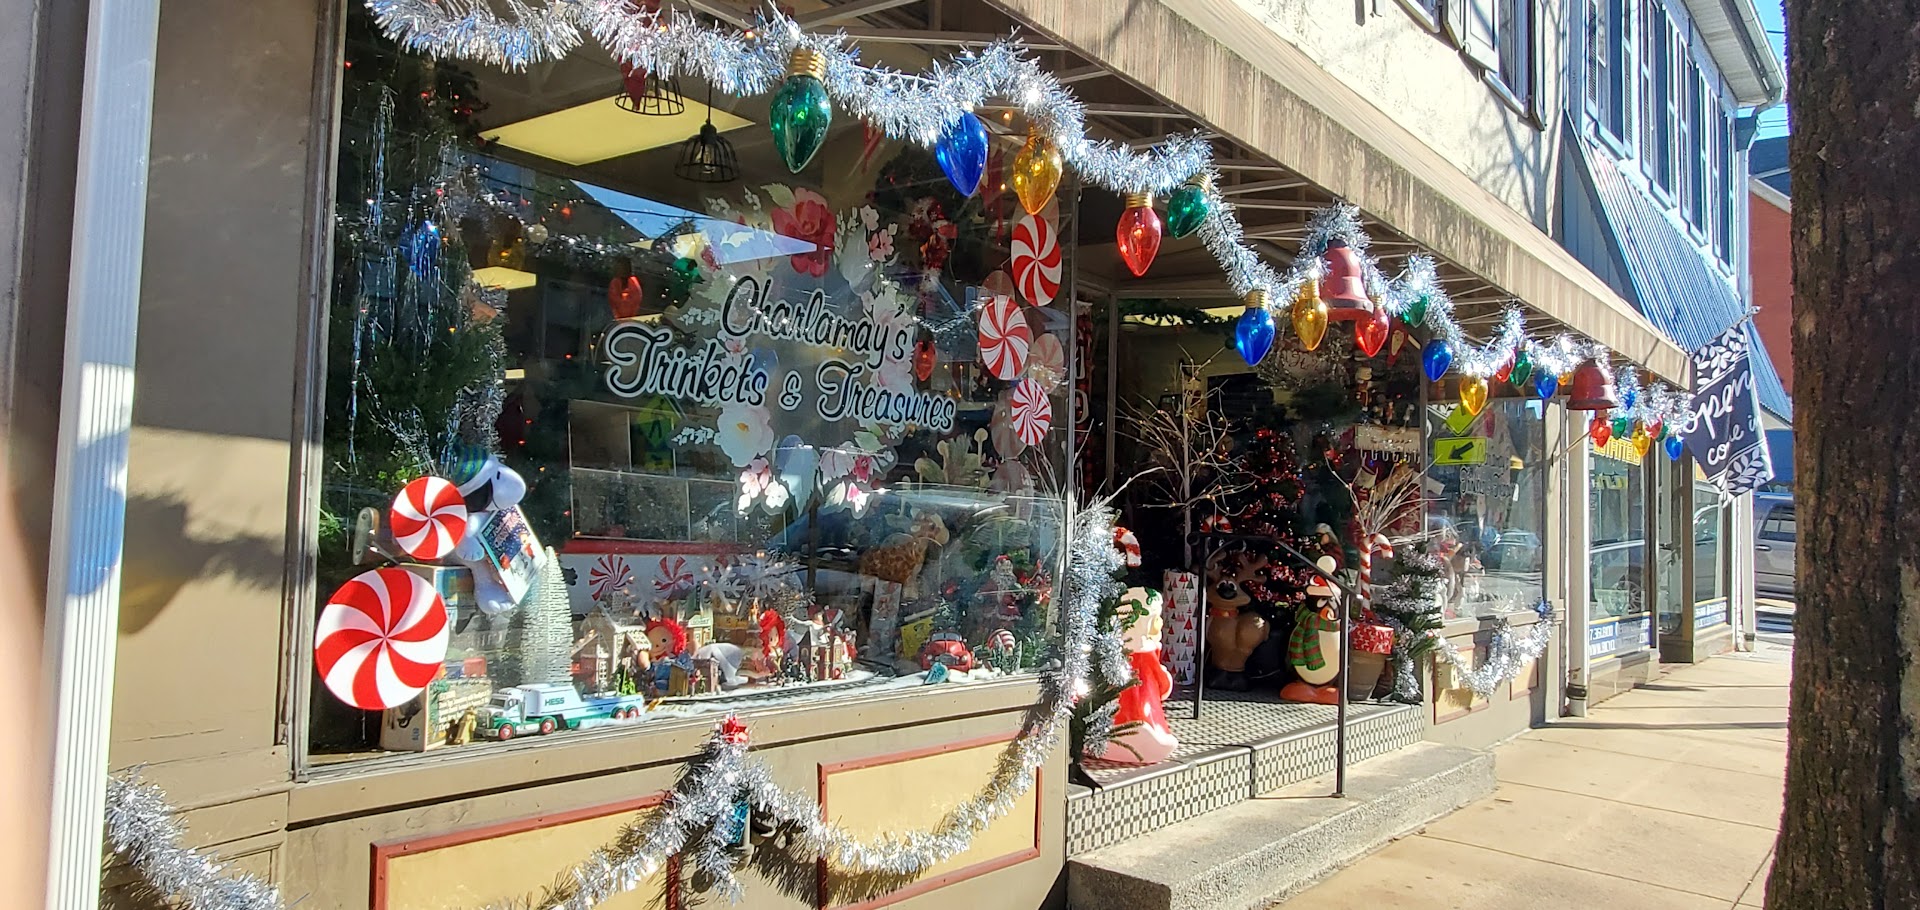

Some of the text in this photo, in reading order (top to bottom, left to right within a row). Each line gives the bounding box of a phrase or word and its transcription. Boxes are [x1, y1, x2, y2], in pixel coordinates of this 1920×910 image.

[720, 275, 909, 370] Charlamay's
[606, 323, 957, 433] Trinkets & Treasures
[1684, 370, 1753, 439] open
[1707, 424, 1744, 465] coe
[544, 697, 565, 706] HESS
